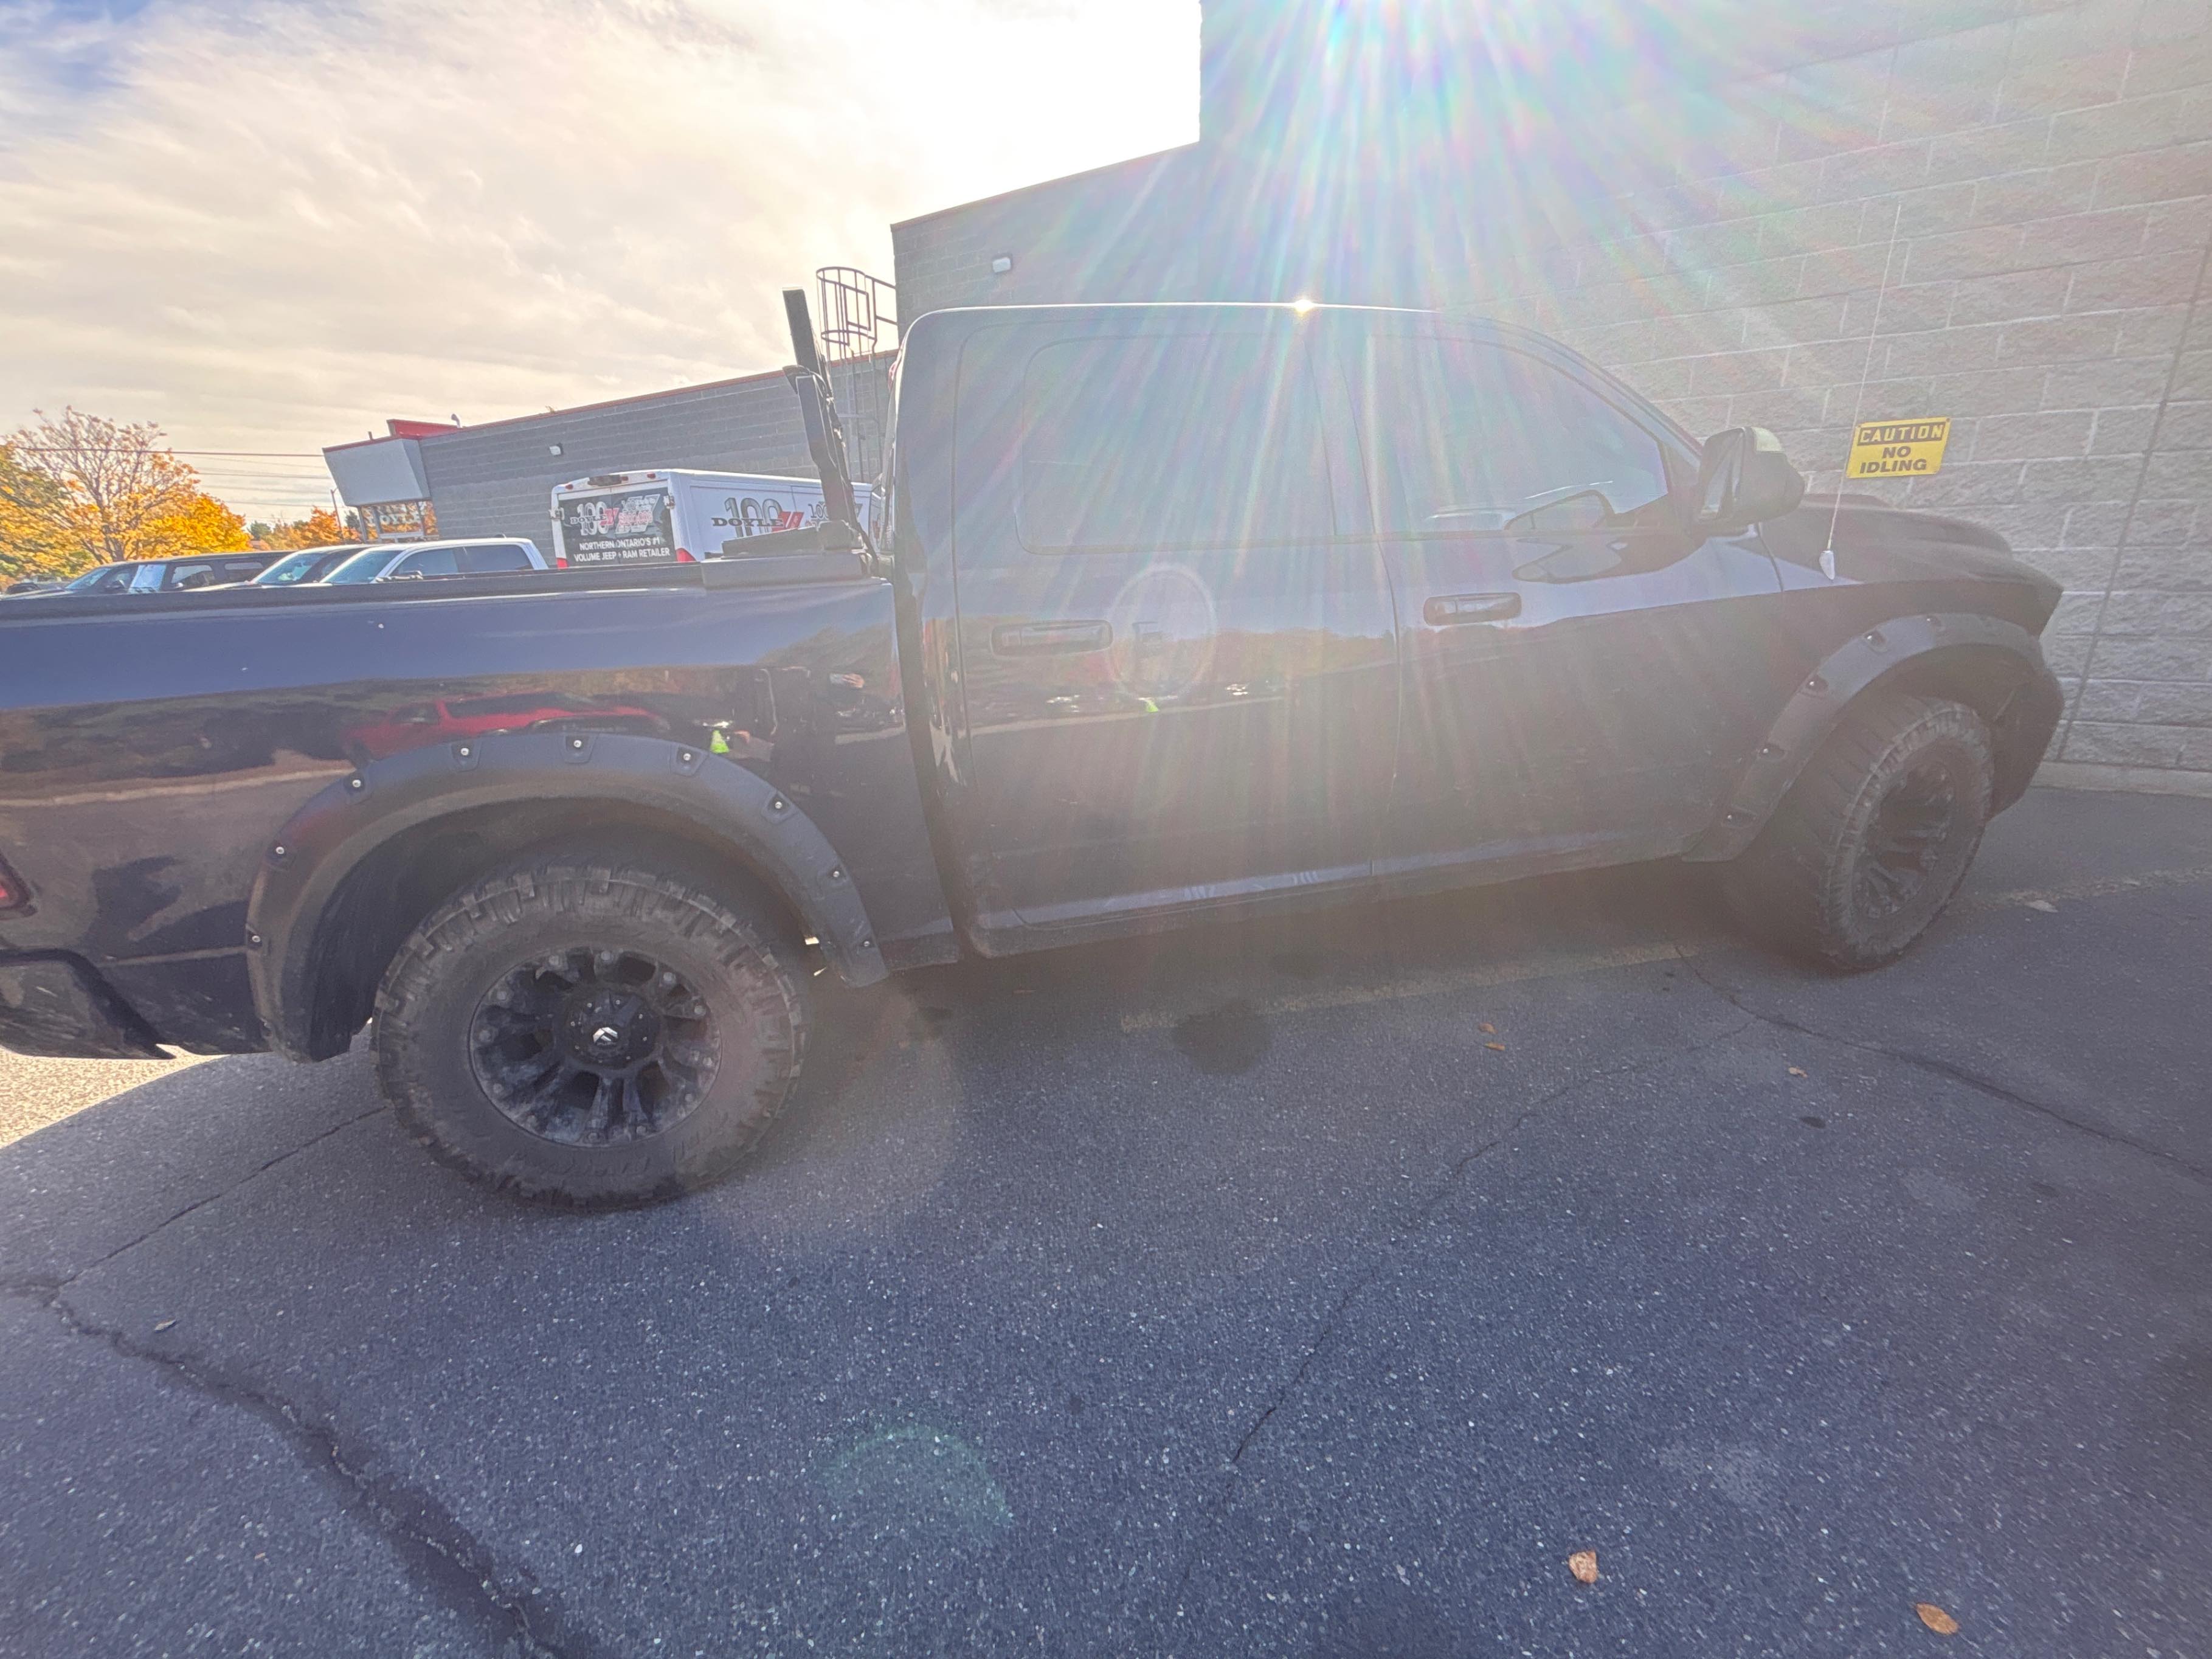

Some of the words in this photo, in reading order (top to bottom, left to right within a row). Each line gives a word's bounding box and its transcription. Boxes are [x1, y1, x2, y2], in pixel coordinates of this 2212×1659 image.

[1860, 424, 1944, 443] CAUTION
[1882, 446, 1911, 458] NO
[1859, 459, 1927, 474] IDLING
[570, 514, 608, 525] DOYLE
[711, 518, 784, 527] DOYLE
[579, 540, 615, 551] NORTHERN
[615, 537, 651, 548] ONTARIO'S
[652, 536, 660, 545] #1
[574, 552, 601, 562] VOLUME
[602, 552, 616, 560] JEEP
[623, 550, 638, 558] RAM
[639, 548, 670, 558] RETAILER
